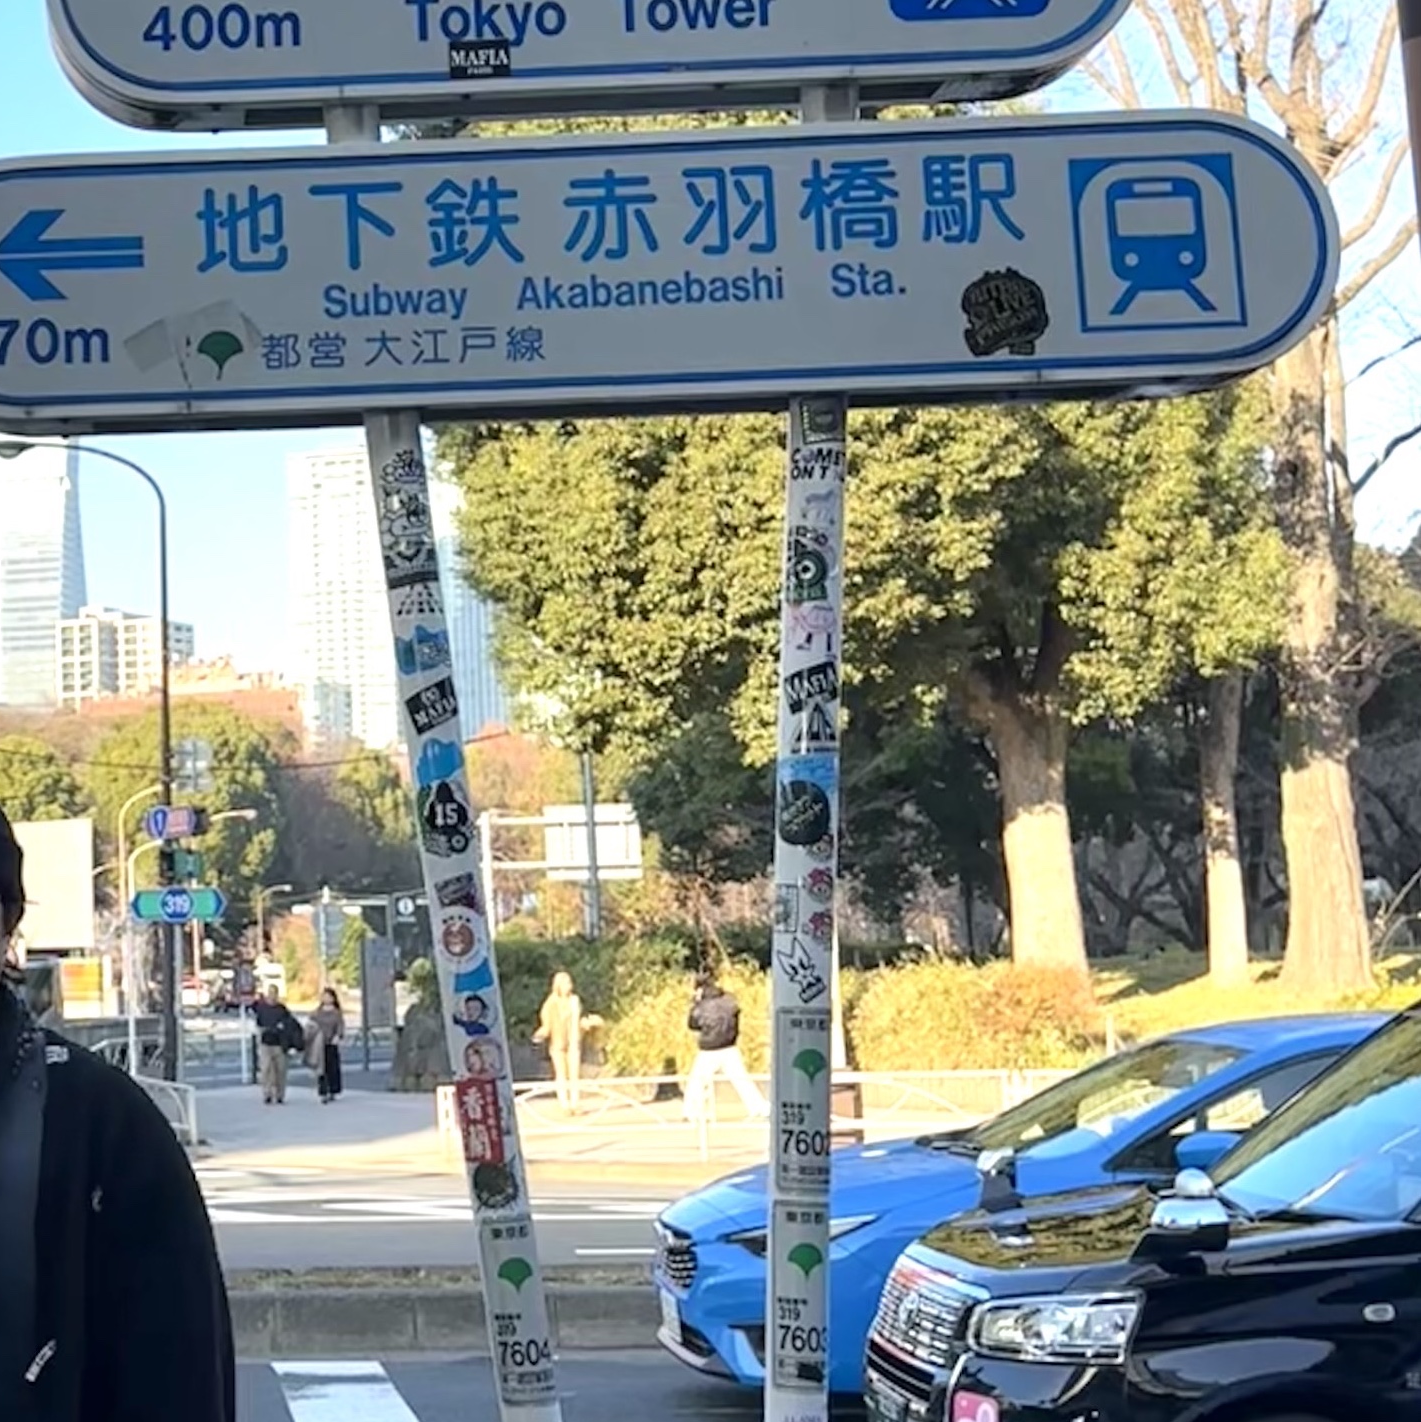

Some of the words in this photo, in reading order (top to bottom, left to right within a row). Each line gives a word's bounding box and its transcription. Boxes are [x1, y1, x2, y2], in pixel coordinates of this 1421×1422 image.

[143, 3, 301, 52] 400m
[405, 0, 567, 47] Tokyo
[619, 0, 773, 32] Tower
[450, 48, 509, 68] MAFIA
[195, 176, 525, 275] 地下鉄
[562, 153, 1025, 263] 赤羽橋駅
[323, 283, 468, 322] Subway
[516, 266, 785, 311] Akabanebashi
[830, 261, 907, 299] Sta.
[262, 332, 347, 370] 都営
[364, 325, 547, 366] 大江戸線
[781, 1129, 830, 1156] 760
